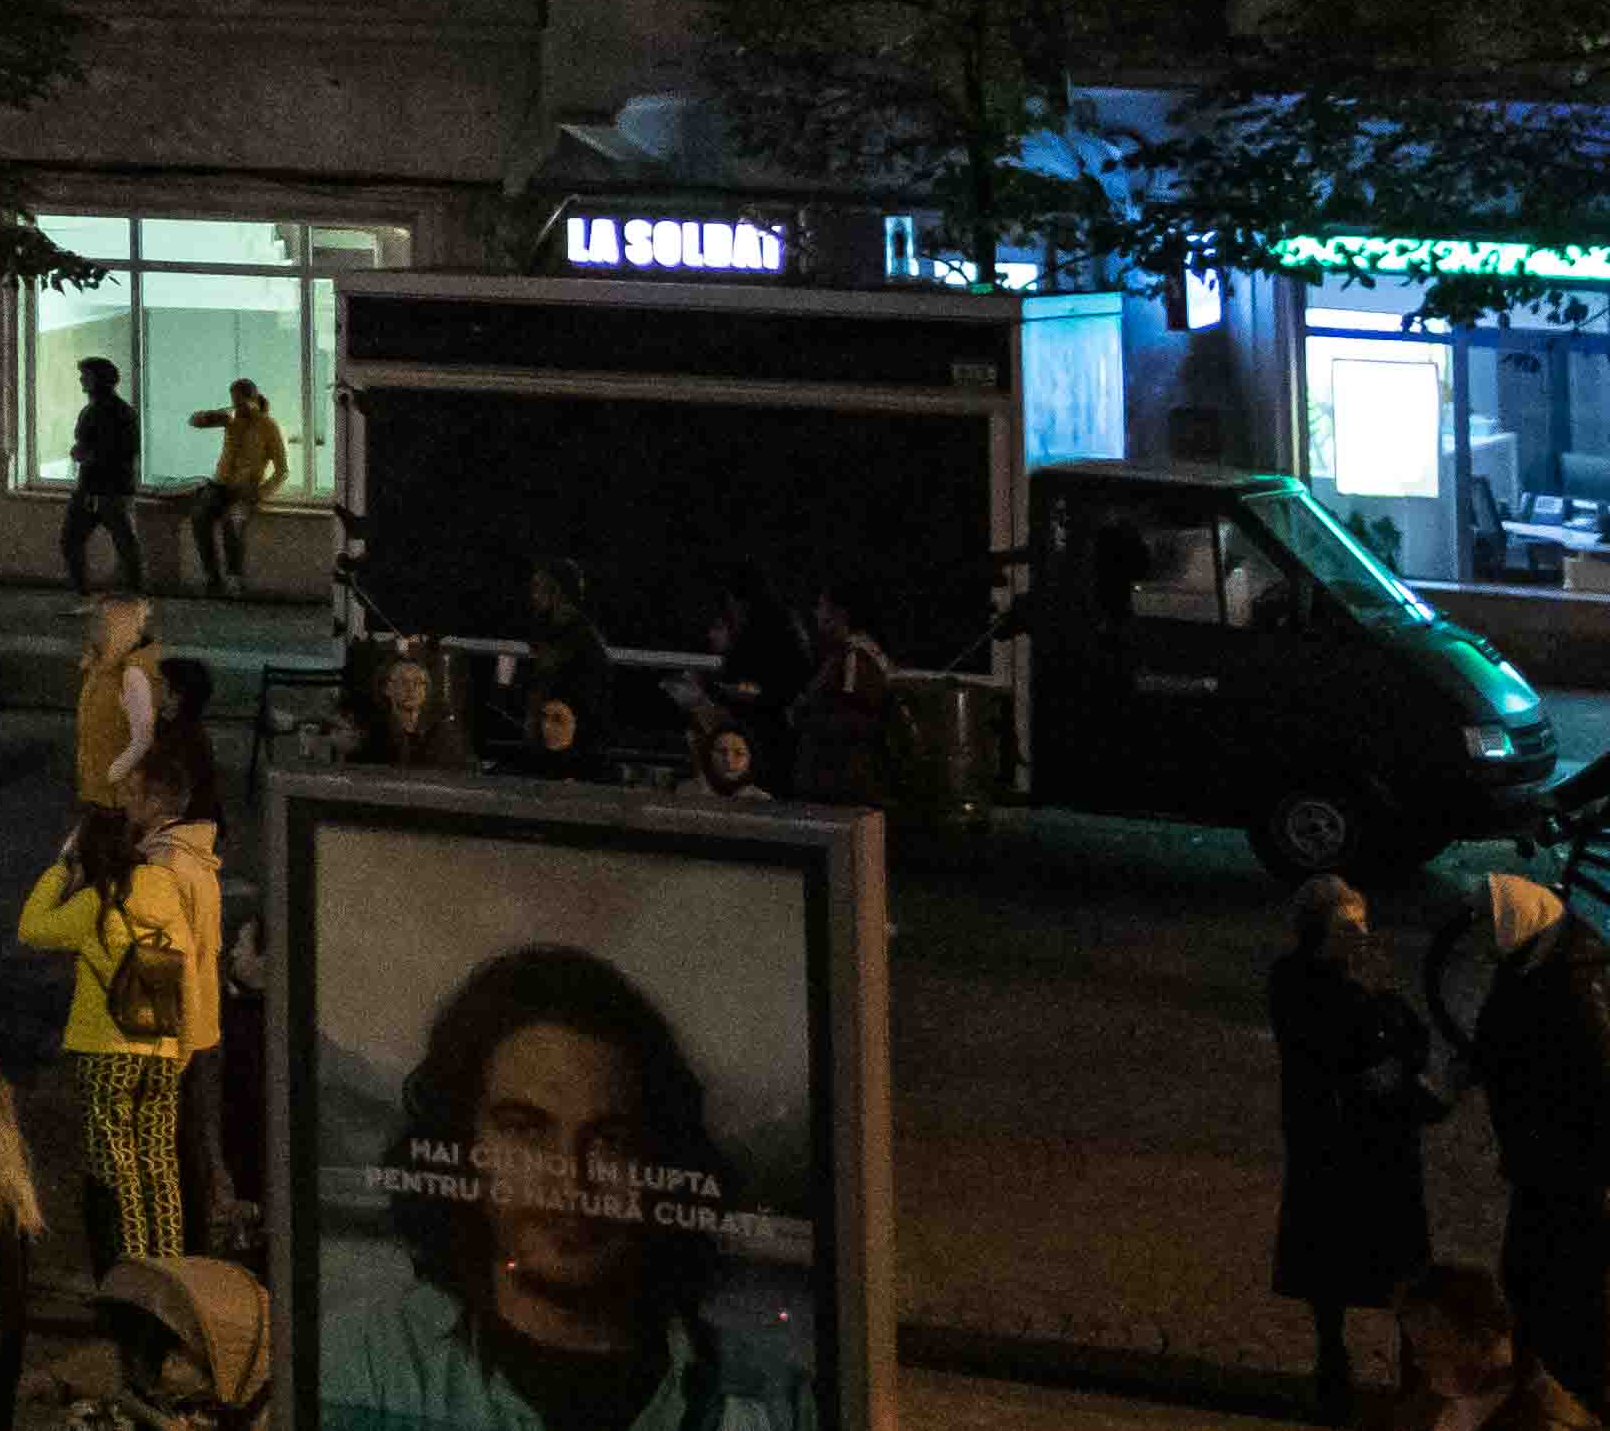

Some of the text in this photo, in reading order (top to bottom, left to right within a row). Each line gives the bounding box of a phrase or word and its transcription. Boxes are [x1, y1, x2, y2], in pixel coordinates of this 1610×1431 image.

[567, 217, 620, 264] LA
[365, 1169, 482, 1202] PENTRU
[409, 1138, 459, 1165] HAI
[627, 1163, 723, 1198] LUPTA
